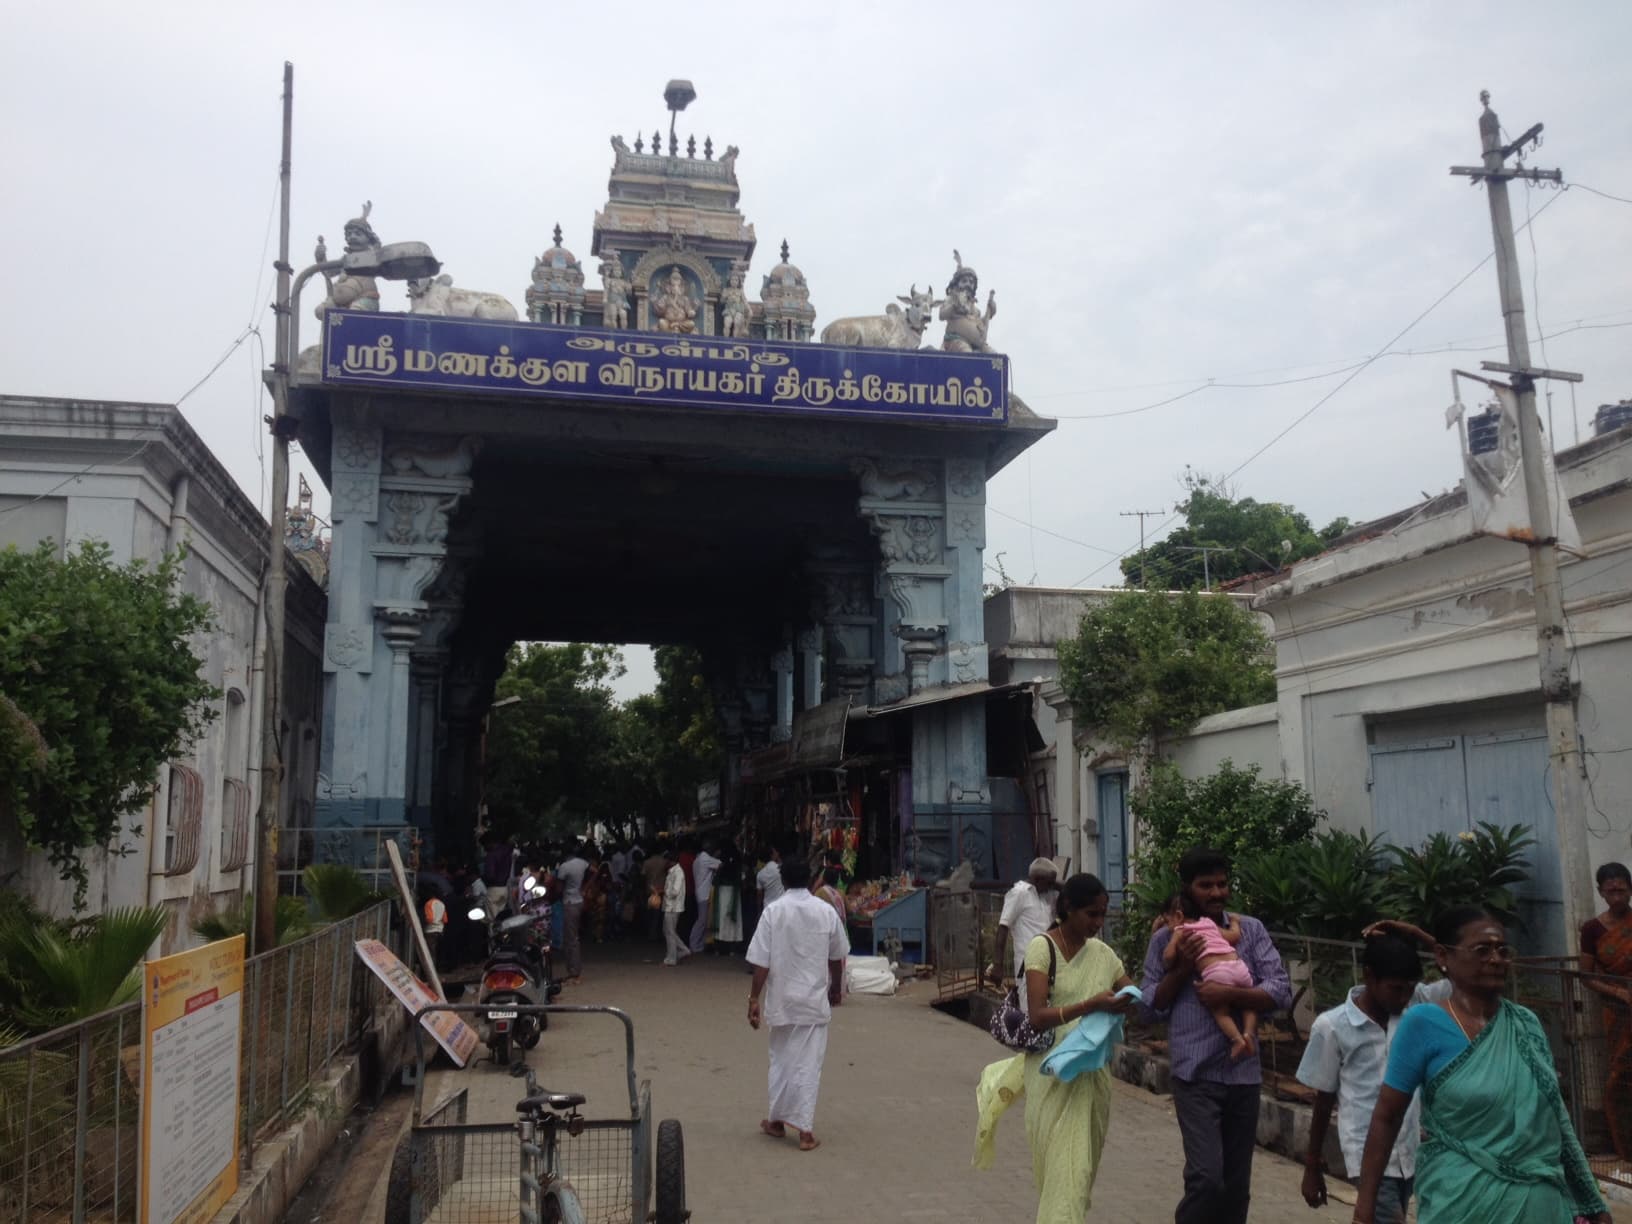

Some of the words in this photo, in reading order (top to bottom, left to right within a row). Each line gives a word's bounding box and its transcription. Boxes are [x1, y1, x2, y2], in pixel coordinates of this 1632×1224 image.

[565, 336, 791, 366] அருள்மிகு
[403, 346, 590, 386] மணக்குள
[599, 356, 766, 396] விநாயகர்
[771, 367, 993, 408] திருக்கோயில்
